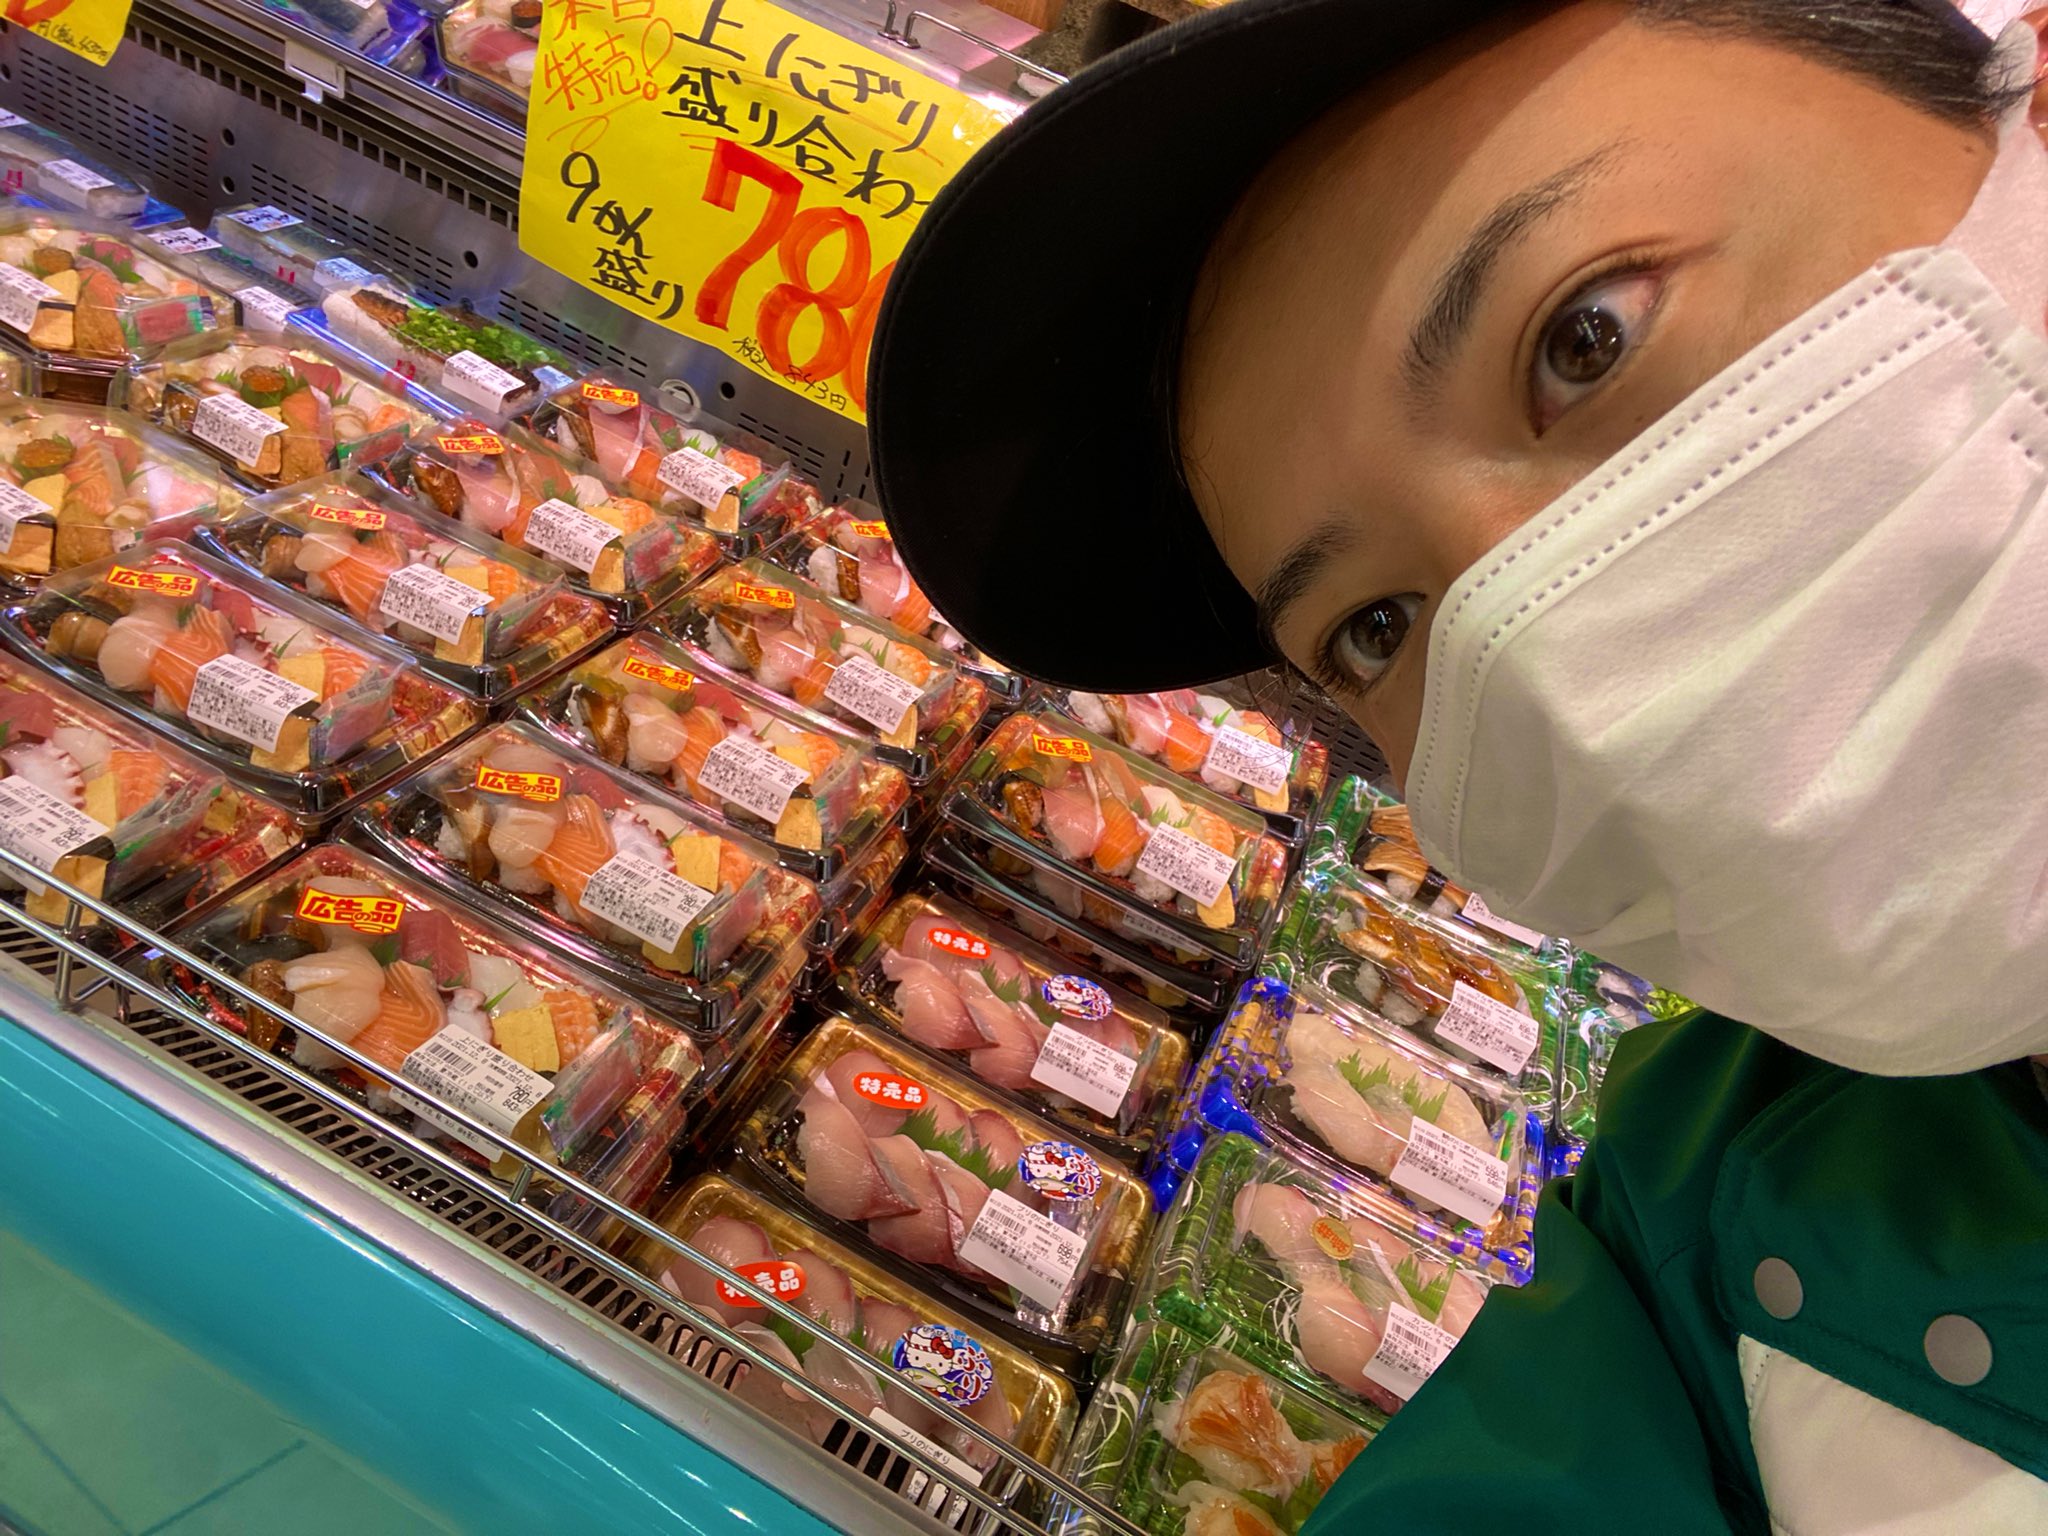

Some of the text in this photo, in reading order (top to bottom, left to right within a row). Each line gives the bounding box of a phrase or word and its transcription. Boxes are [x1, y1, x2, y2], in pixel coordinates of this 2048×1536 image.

[662, 66, 932, 219] 盛り合わ
[480, 772, 562, 797] 広告の品
[300, 895, 402, 927] 広告の品
[458, 1032, 535, 1084] 上にぎり盛り合わせ
[859, 1077, 923, 1103] 特売品
[898, 1427, 950, 1466] ブリのにぎり
